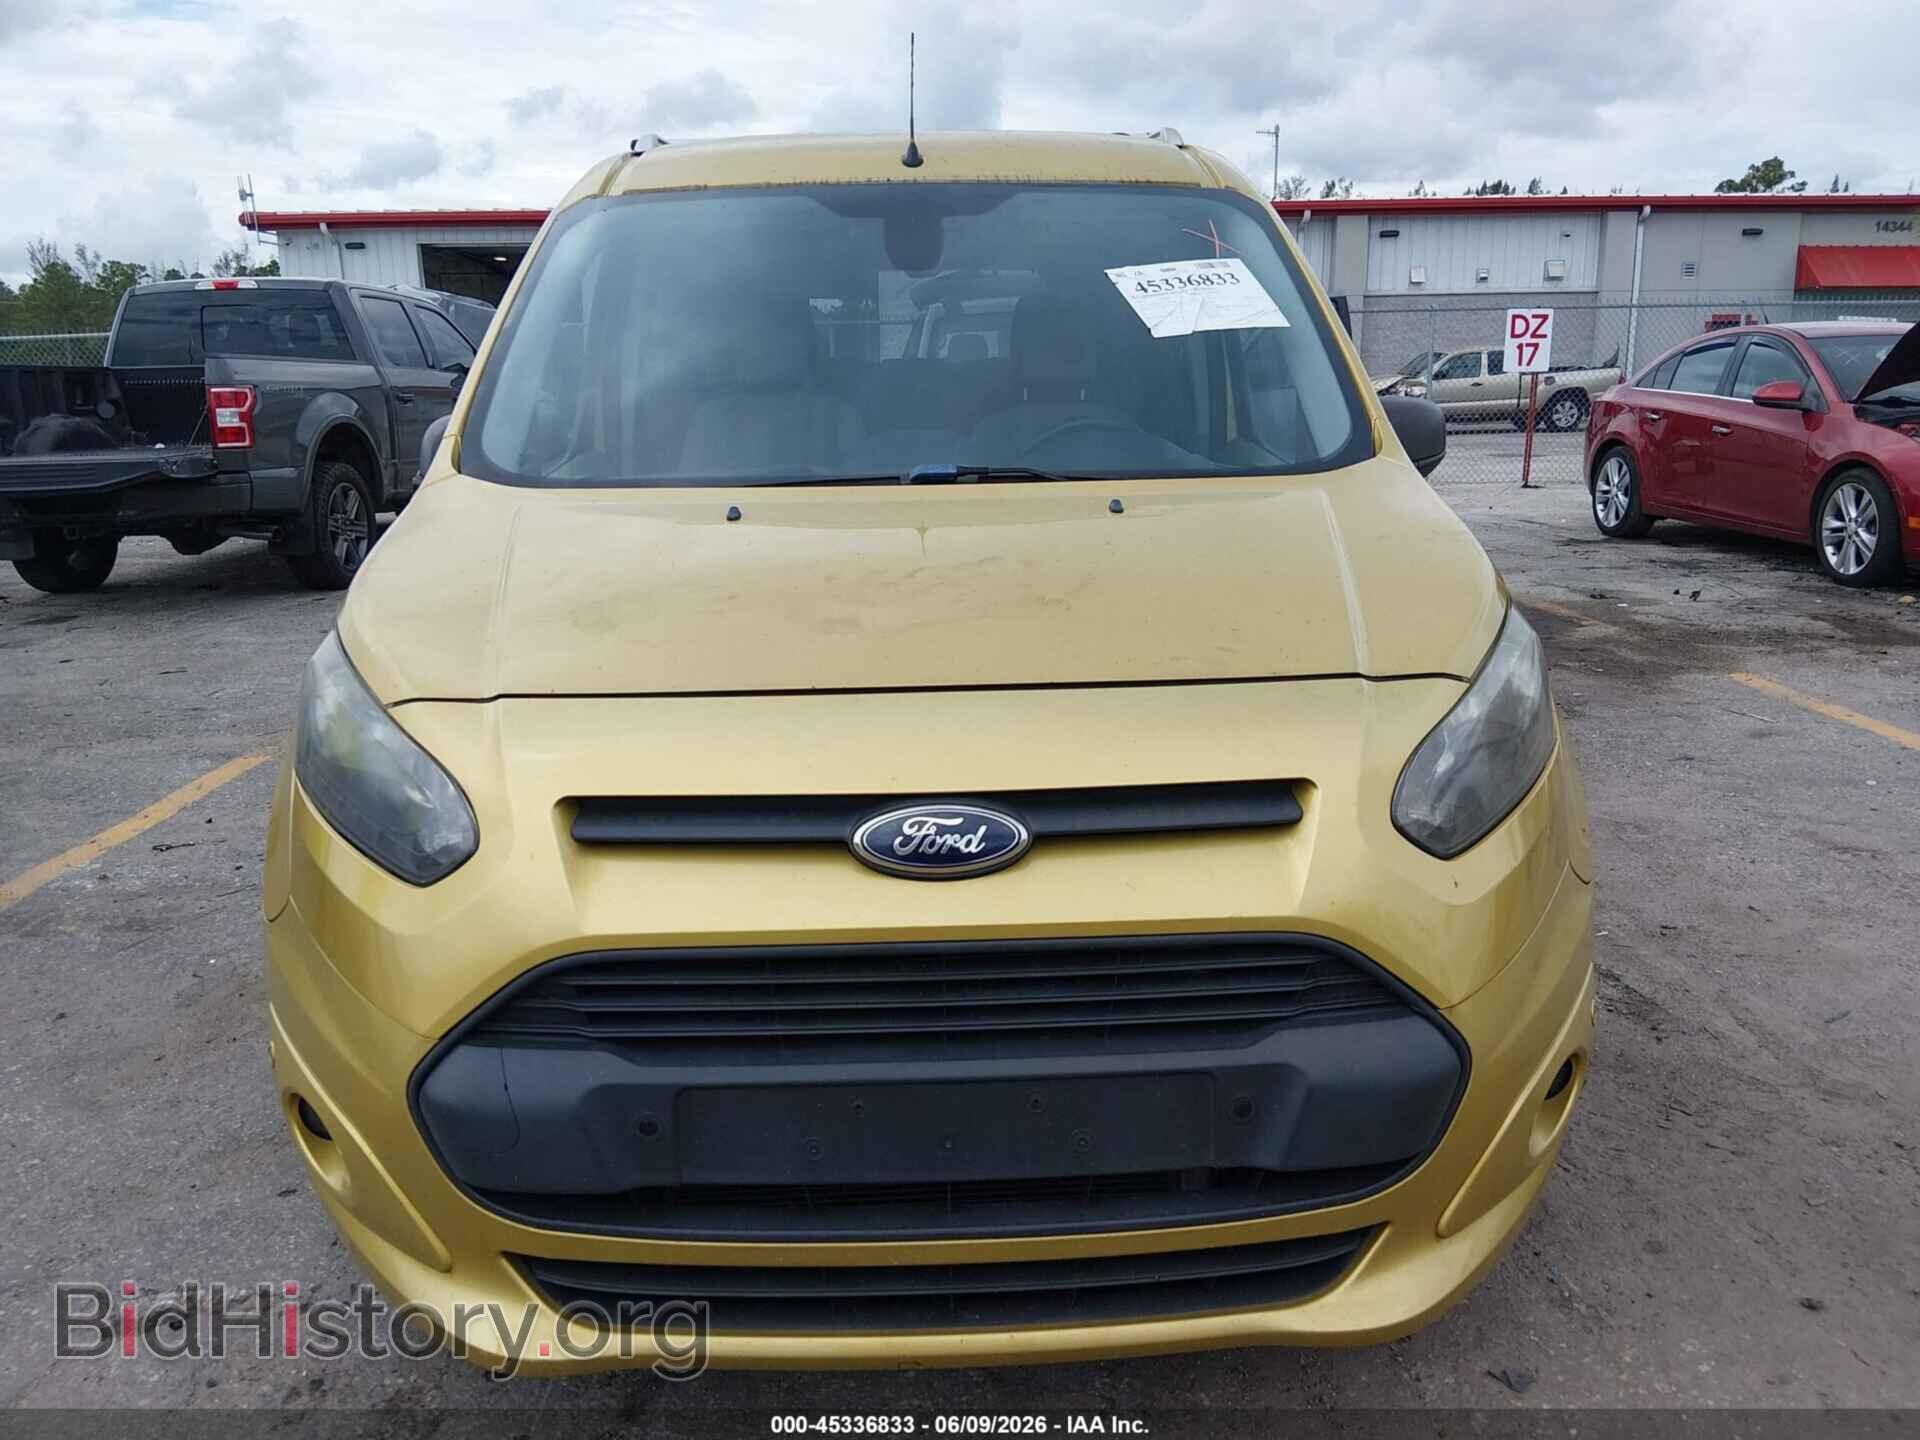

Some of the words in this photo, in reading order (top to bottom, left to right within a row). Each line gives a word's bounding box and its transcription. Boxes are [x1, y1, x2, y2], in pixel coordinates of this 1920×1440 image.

[1135, 272, 1241, 294] 45336833
[1510, 314, 1549, 339] DZ
[1516, 342, 1540, 367] 17
[893, 816, 987, 856] Ford
